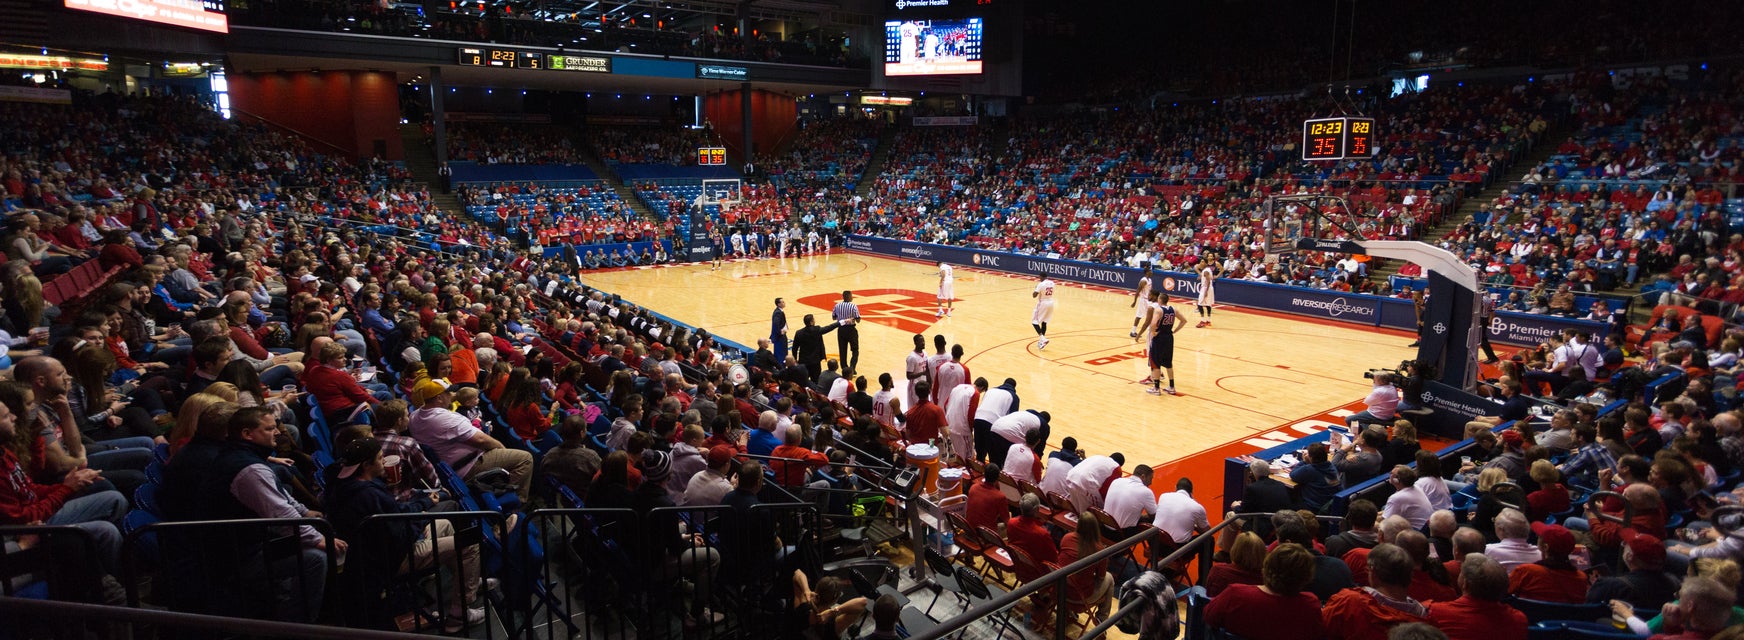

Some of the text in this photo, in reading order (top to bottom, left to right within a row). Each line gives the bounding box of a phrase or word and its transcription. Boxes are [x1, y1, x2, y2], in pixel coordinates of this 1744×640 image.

[473, 56, 480, 65] 8
[491, 50, 516, 61] 12:23
[565, 57, 607, 67] GRUNDER
[531, 59, 538, 69] 5
[1311, 122, 1343, 135] 12:23
[1352, 122, 1370, 134] 12:23
[1312, 137, 1336, 155] 35
[1352, 136, 1367, 154] 35
[692, 245, 711, 254] meijer
[981, 254, 1000, 267] PNC
[1027, 260, 1125, 283] UNIVERSITY of DAYTON
[1292, 297, 1374, 316] RIVERSIDE RESEARCH
[1509, 323, 1556, 337] Premier
[1508, 333, 1534, 341] Miami
[1534, 336, 1551, 344] Vall
[873, 401, 884, 416] 40
[1461, 403, 1486, 416] Health
